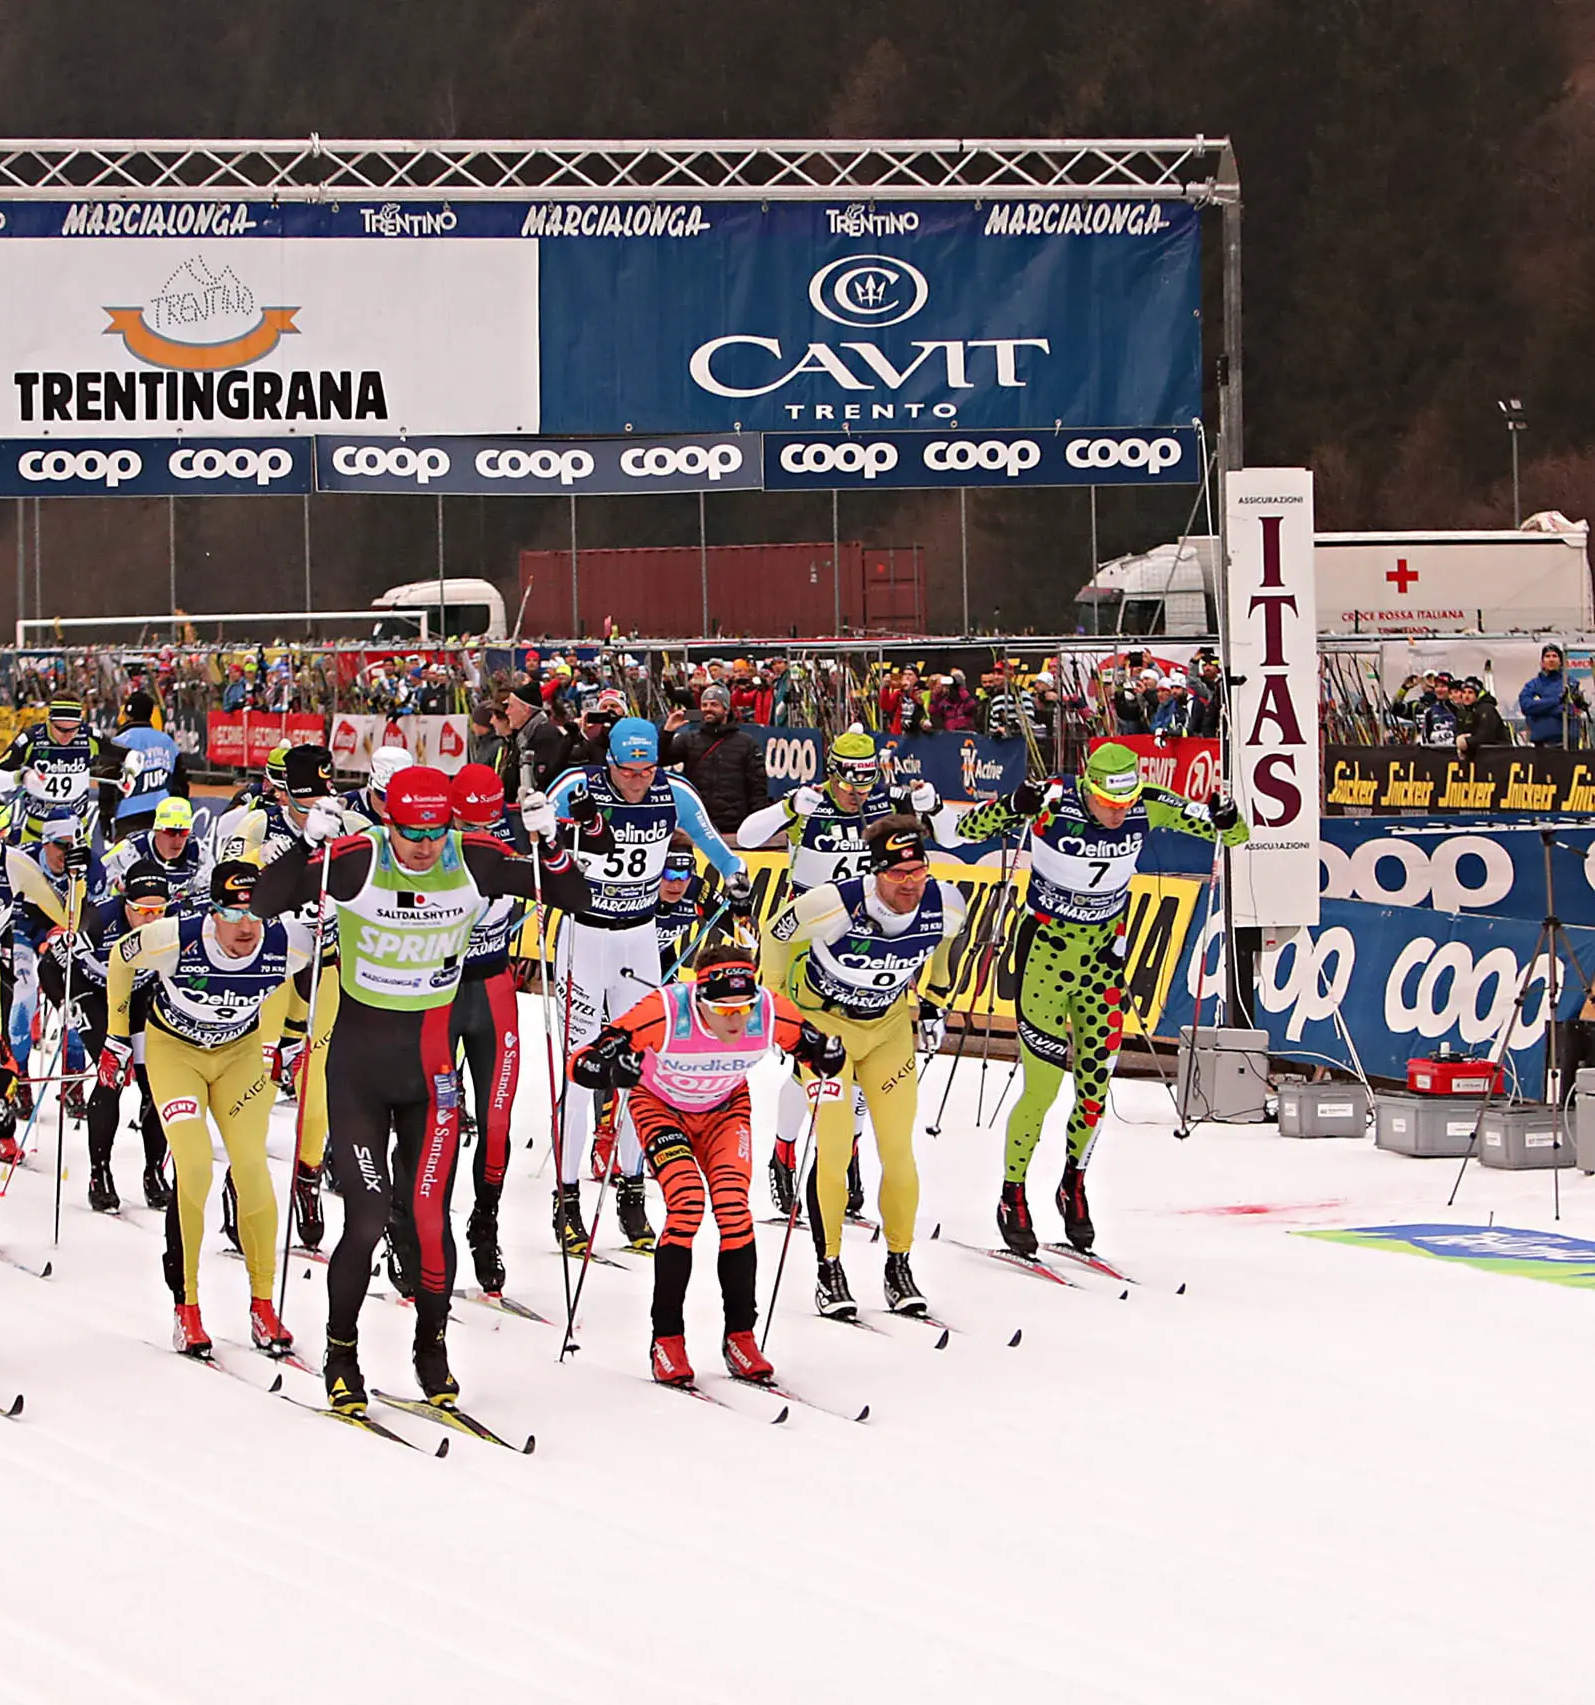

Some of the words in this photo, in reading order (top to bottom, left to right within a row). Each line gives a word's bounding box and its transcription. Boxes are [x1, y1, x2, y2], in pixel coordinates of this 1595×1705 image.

[62, 203, 256, 236] MARCIALONGA
[361, 206, 457, 237] TRENTINO
[522, 205, 711, 237] MARCIALONGA
[825, 207, 919, 238] TRENTINO
[985, 204, 1169, 236] MARCIALONGA
[150, 285, 254, 329] TRENTINO
[689, 335, 1050, 399] CAVIT
[13, 370, 388, 422] TRENTINGRANA
[785, 403, 958, 420] TRENTO
[18, 449, 143, 488] coop
[168, 448, 293, 487] coop
[332, 445, 450, 484] coop
[474, 447, 594, 486] coop
[619, 443, 743, 482] coop
[780, 442, 898, 480] coop
[923, 439, 1041, 477] coop
[1065, 437, 1182, 475] coop
[1238, 496, 1304, 505] ASSICURAZIONI
[1378, 611, 1414, 621] ROSSA
[1416, 609, 1465, 620] ITALIANA
[1246, 515, 1307, 828] ITAS
[766, 737, 817, 783] coop
[894, 755, 922, 776] Active
[975, 758, 1004, 782] Active
[45, 776, 74, 799] 49
[413, 793, 448, 804] Santander
[1058, 831, 1144, 858] Melinda
[603, 848, 648, 878] 58
[833, 855, 871, 880] 65
[1088, 861, 1111, 889] 7
[1320, 836, 1514, 912] op
[376, 906, 465, 921] SALTDALSHYTTA
[1038, 894, 1054, 911] 43
[180, 965, 210, 974] coop
[261, 965, 271, 974] 70
[272, 965, 285, 974] KM
[1019, 1021, 1067, 1055] SILVINI
[493, 1049, 518, 1111] Santander
[662, 1054, 760, 1075] NordicBe
[420, 1126, 450, 1199] Santander
